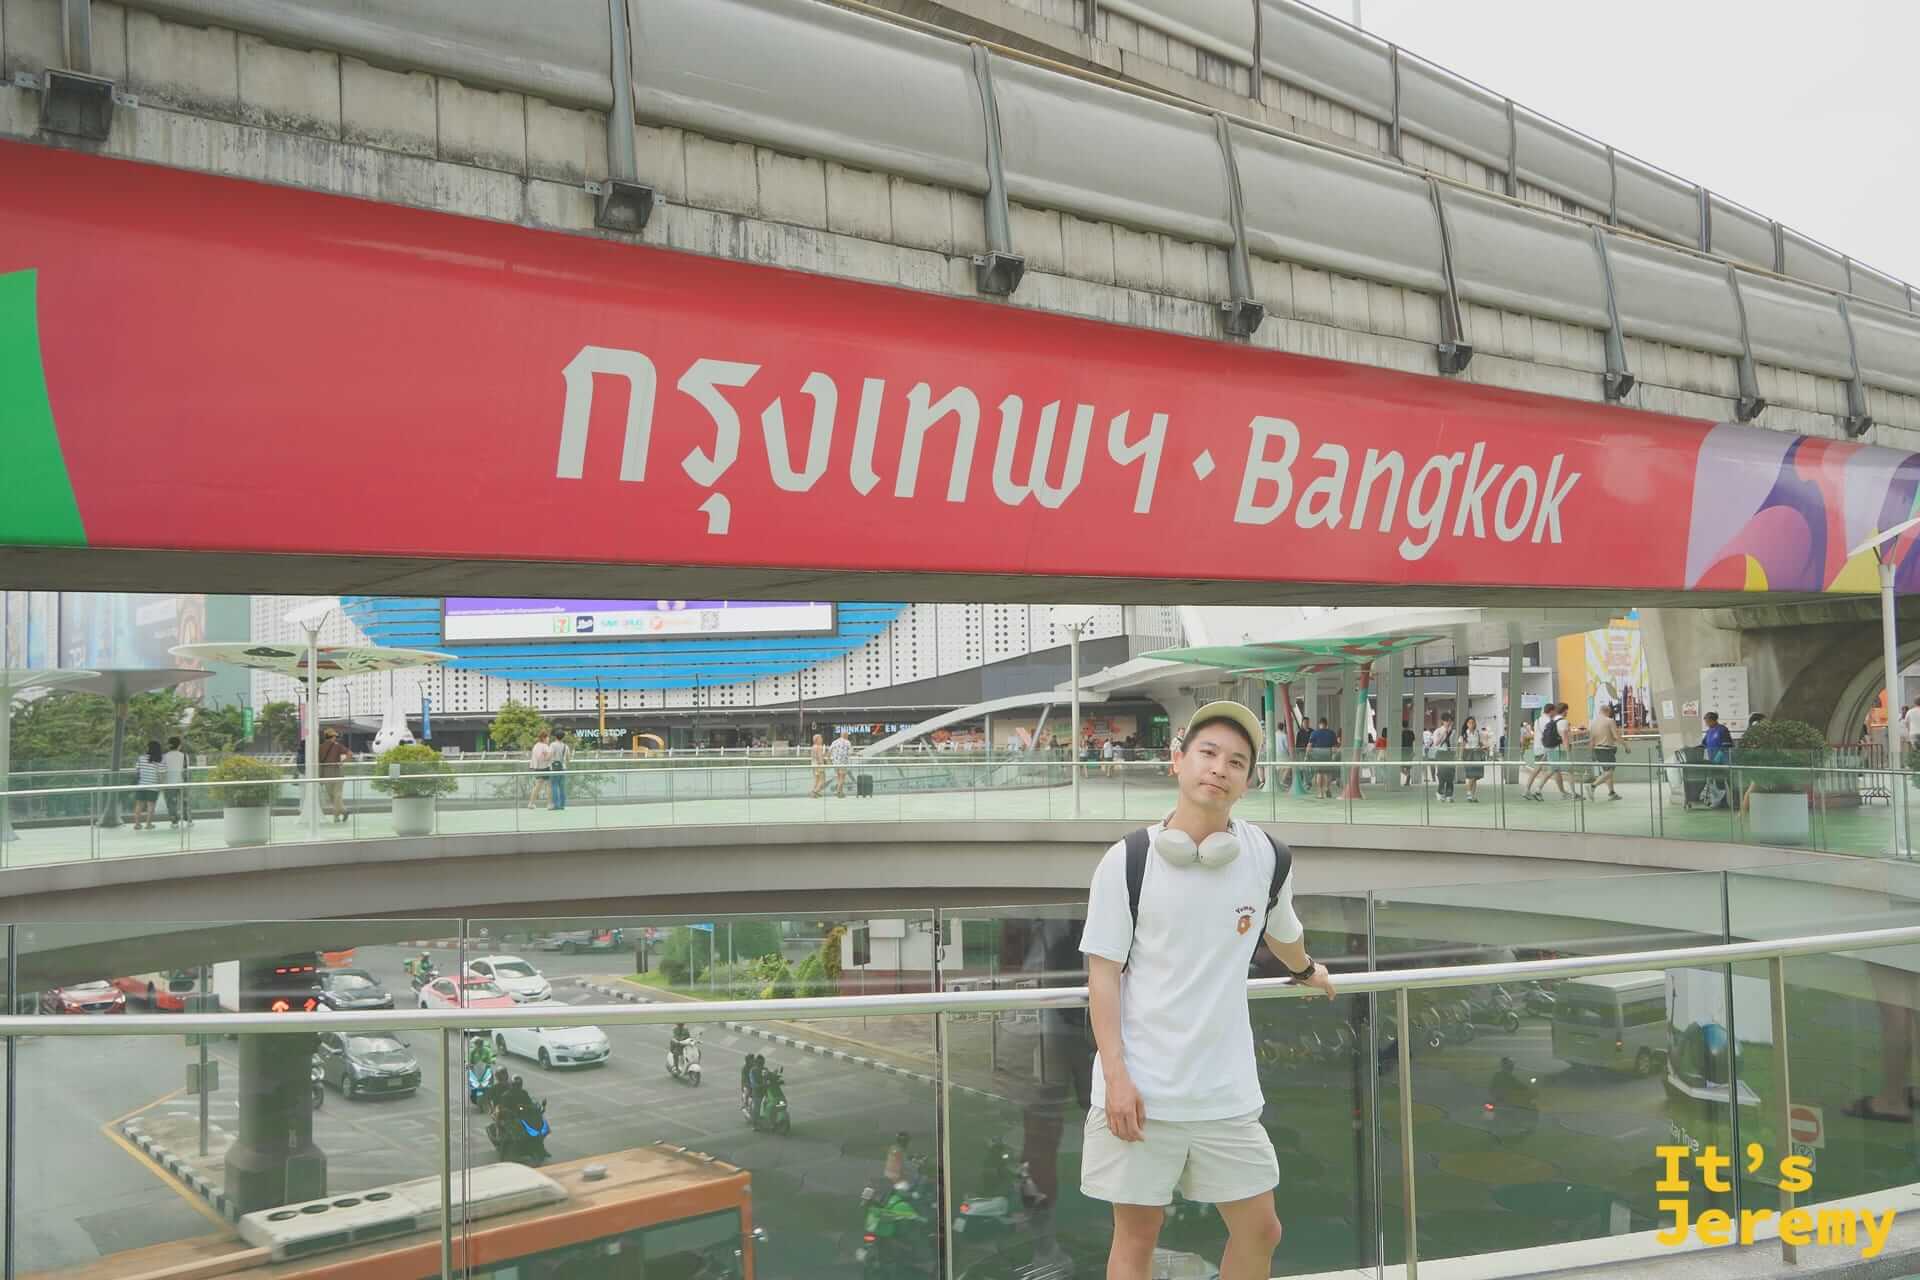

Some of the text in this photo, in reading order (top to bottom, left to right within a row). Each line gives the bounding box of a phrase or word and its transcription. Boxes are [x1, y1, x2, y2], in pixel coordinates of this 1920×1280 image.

[556, 345, 1168, 535] กรุงเทพฯ
[1233, 415, 1582, 561] Bangkok
